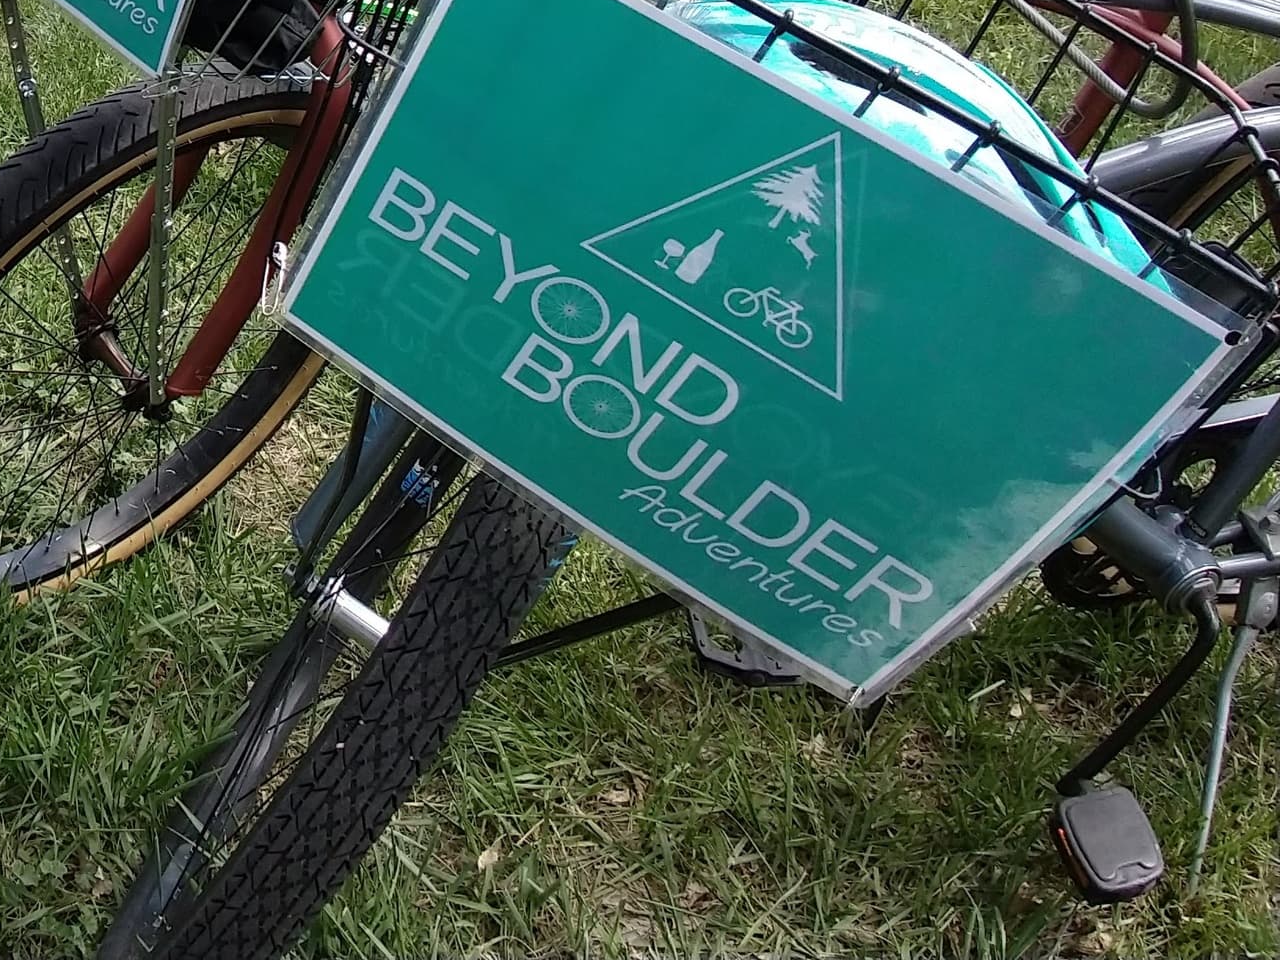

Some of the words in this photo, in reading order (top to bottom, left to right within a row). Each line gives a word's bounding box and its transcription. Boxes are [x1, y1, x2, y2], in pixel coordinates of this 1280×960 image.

[368, 167, 740, 426] BEYOND
[501, 333, 934, 630] BOULDER
[619, 484, 884, 647] Adventures
